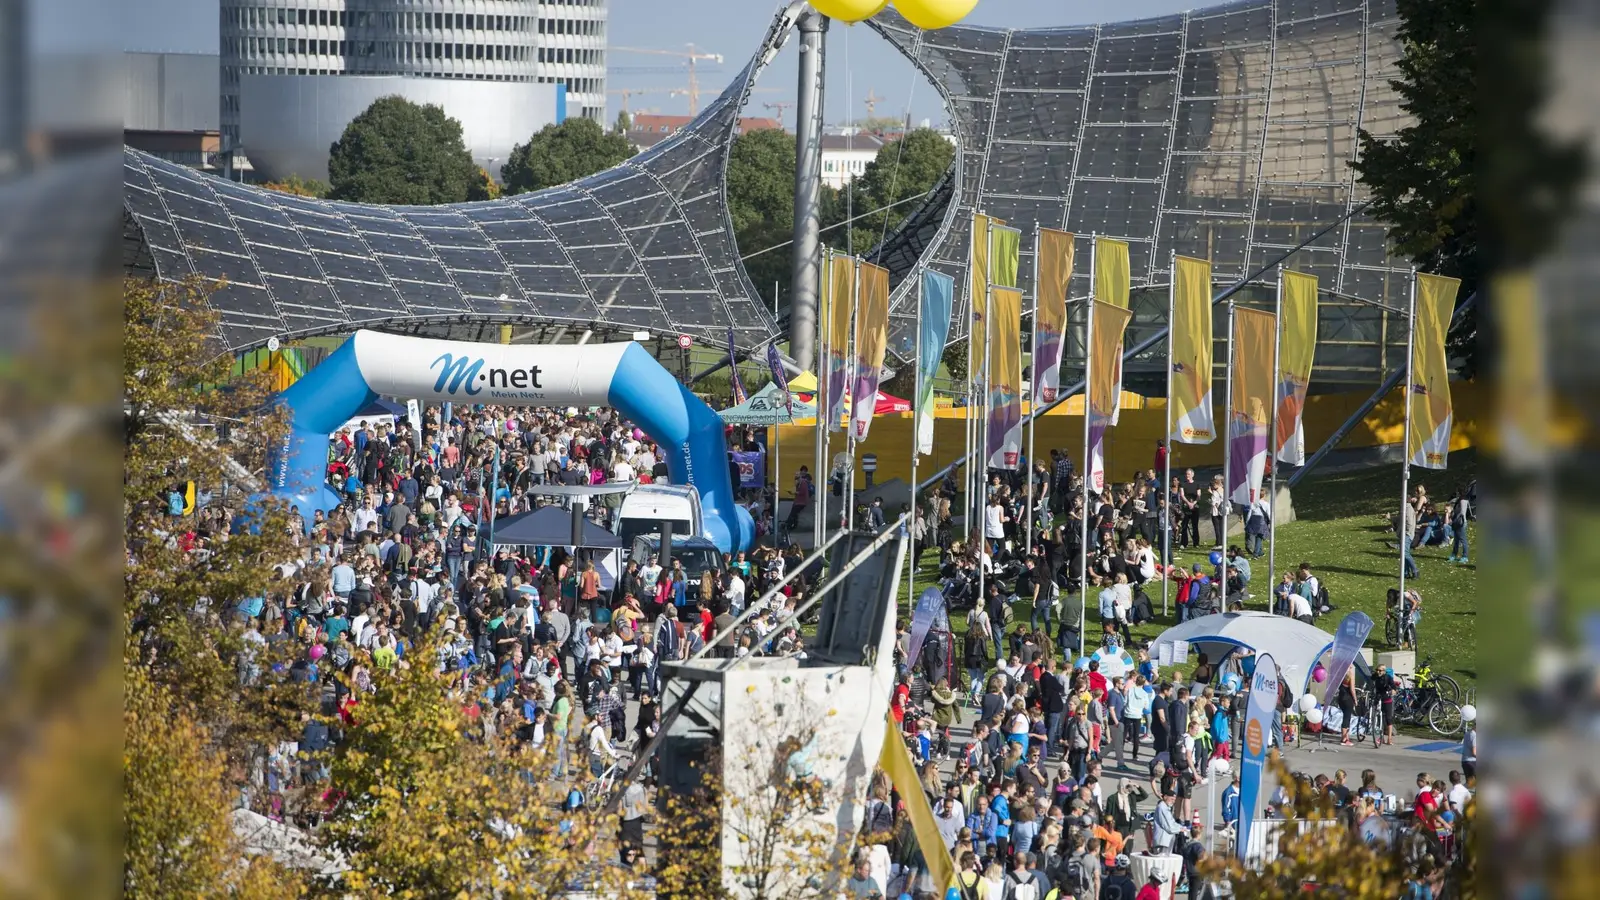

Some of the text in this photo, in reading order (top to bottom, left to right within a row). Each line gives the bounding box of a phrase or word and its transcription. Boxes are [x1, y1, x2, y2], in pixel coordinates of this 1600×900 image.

[491, 390, 546, 399] Mein Netz
[721, 414, 792, 423] SNOWBOARDNG
